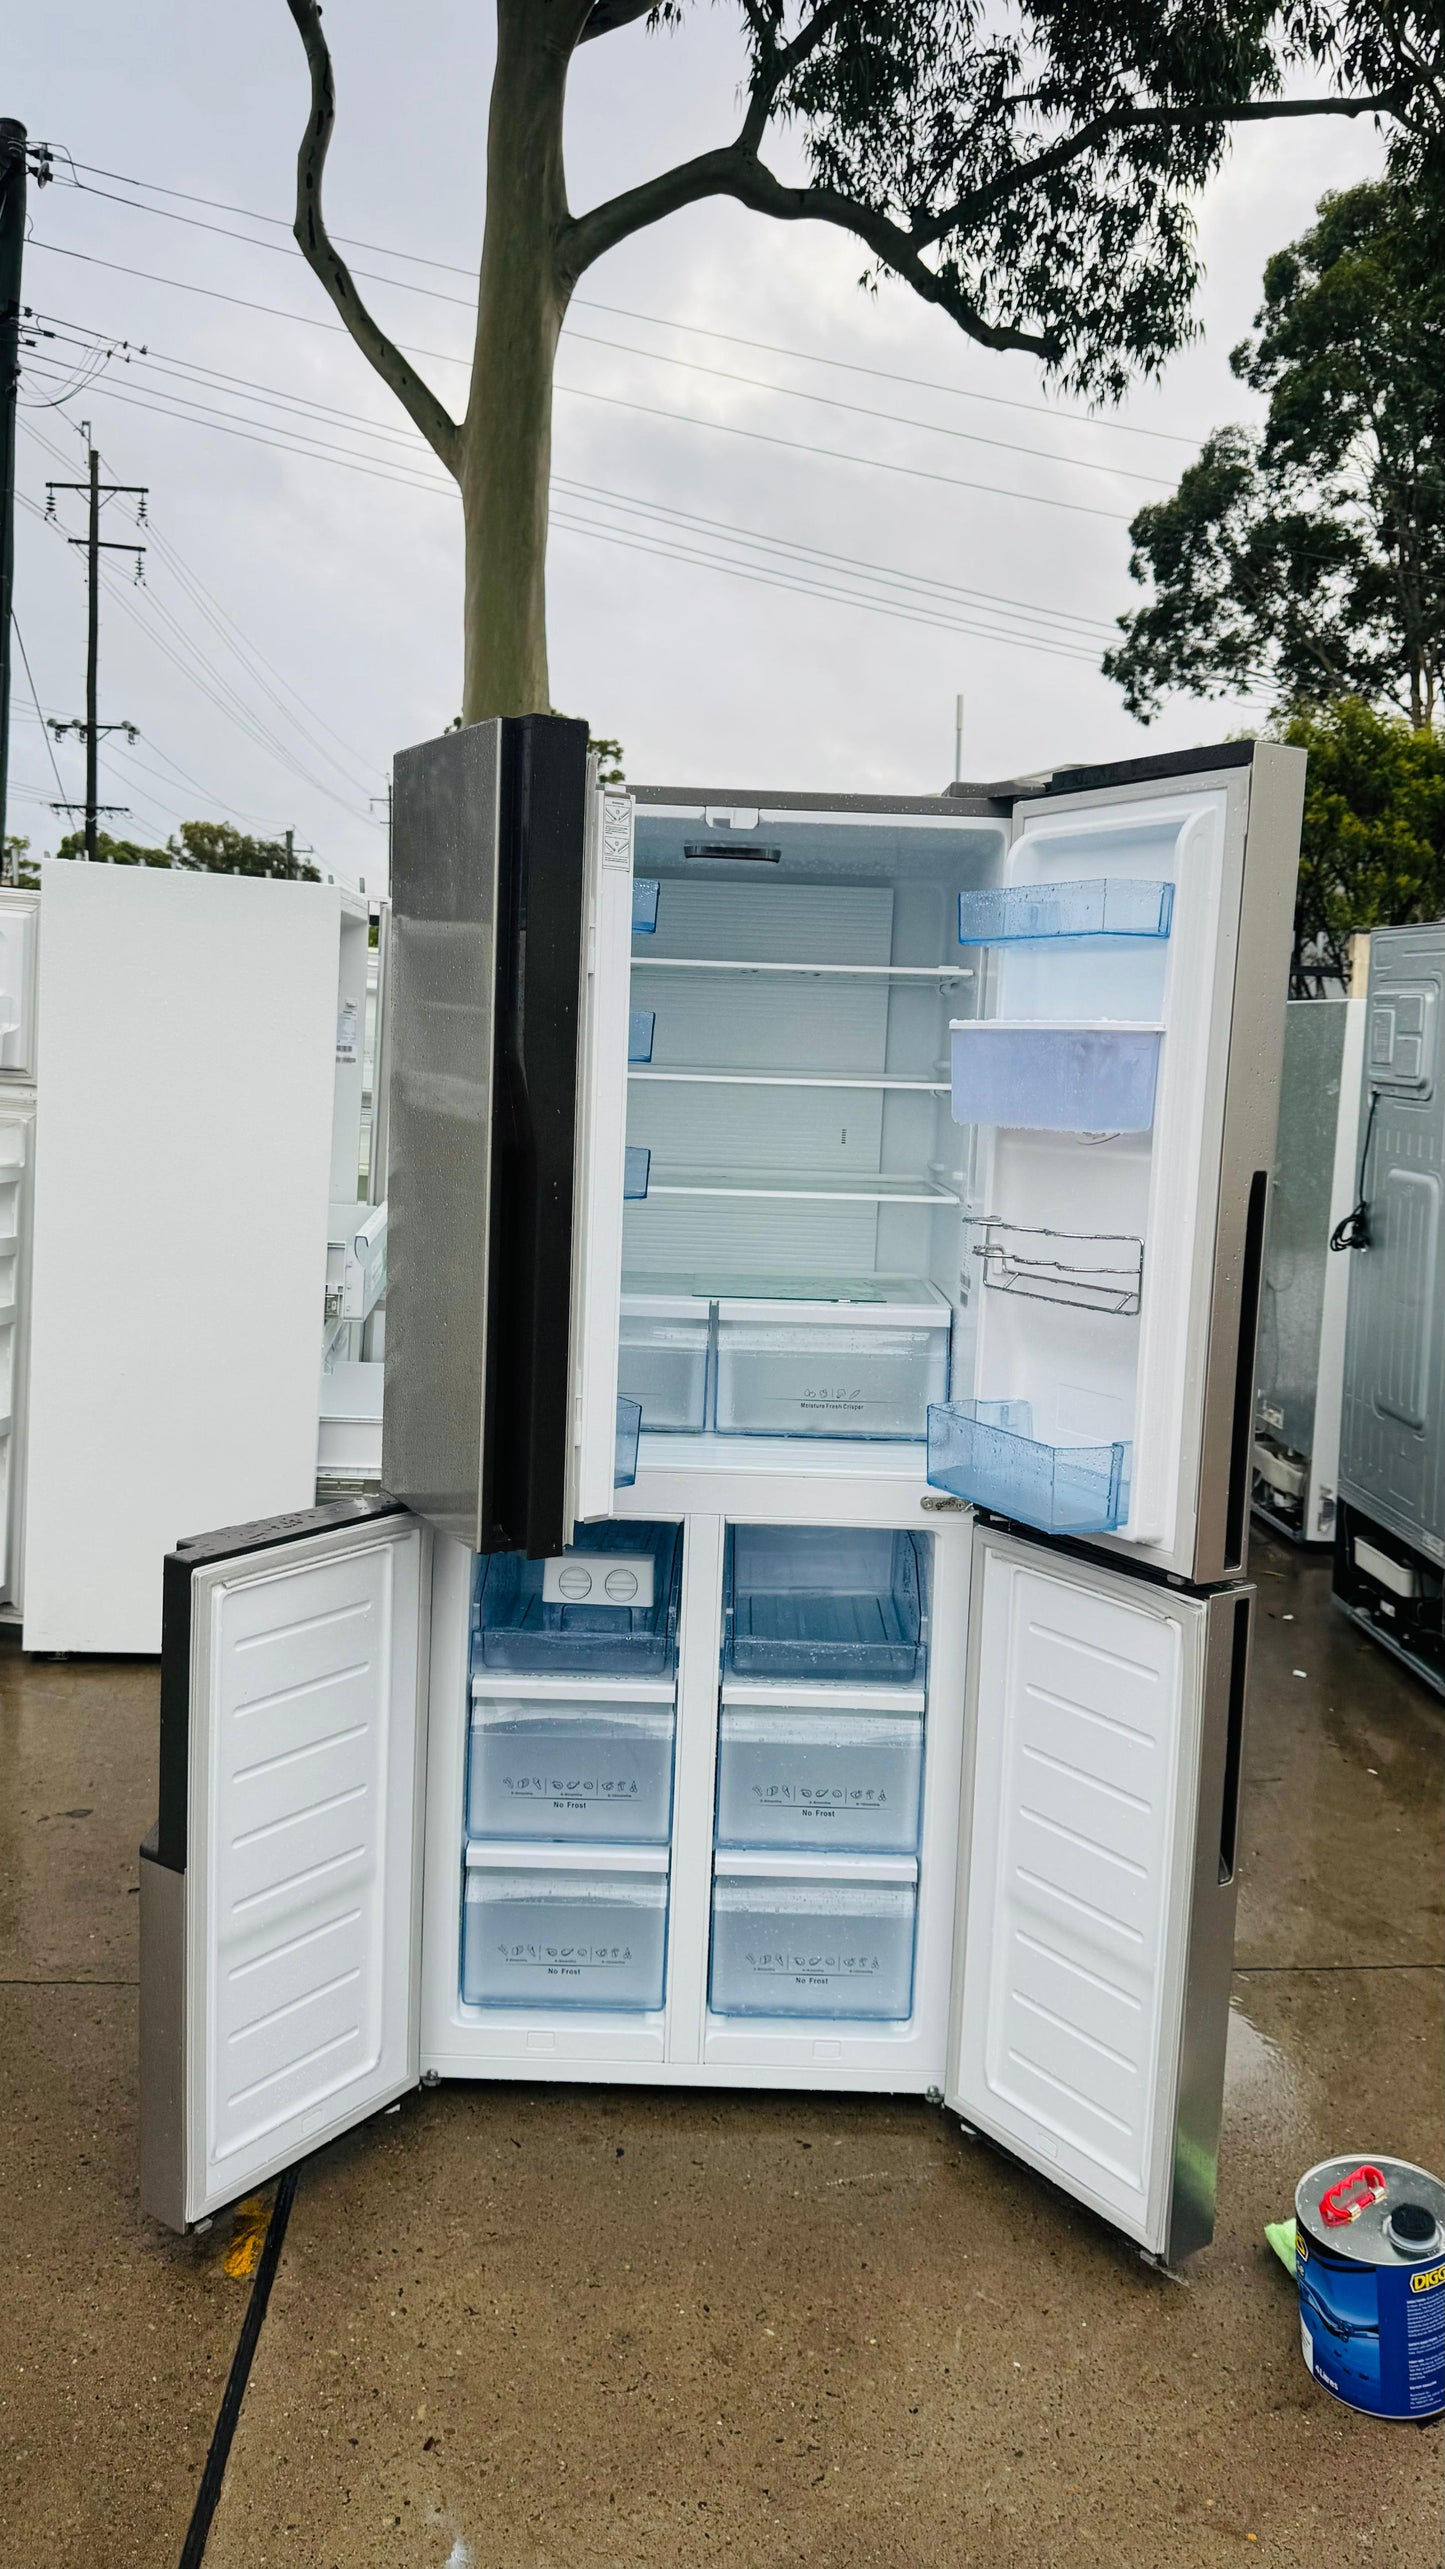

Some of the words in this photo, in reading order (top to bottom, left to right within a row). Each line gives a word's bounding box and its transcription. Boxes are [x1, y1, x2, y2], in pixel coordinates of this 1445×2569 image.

[843, 1403, 864, 1411] Crisper
[553, 1801, 564, 1809] No
[567, 1801, 586, 1809] Frost
[802, 1809, 812, 1817] No
[816, 1809, 835, 1817] Frost
[809, 1977, 829, 1985] Frost
